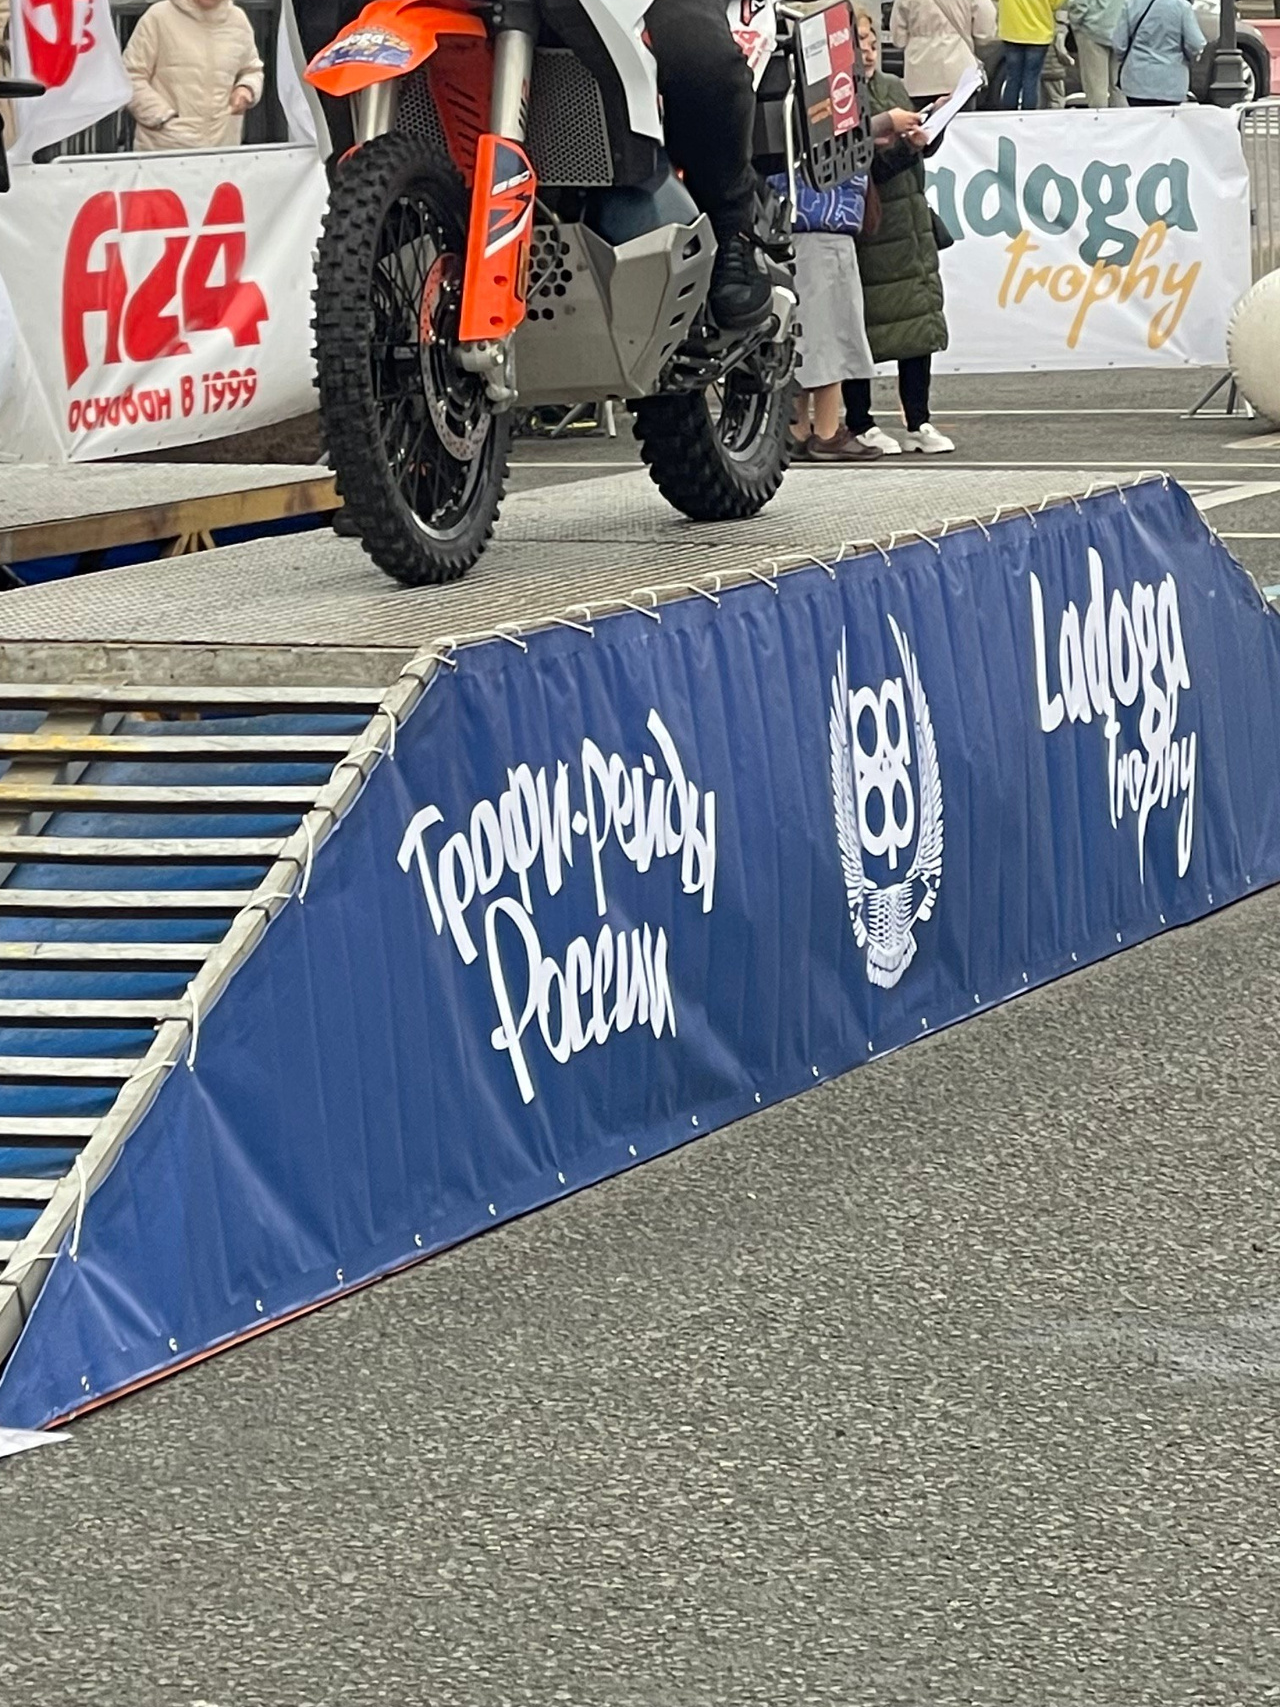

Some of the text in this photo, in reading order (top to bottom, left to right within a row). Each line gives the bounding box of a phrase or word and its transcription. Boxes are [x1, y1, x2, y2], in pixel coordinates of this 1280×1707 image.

[924, 135, 1198, 268] adoga
[998, 220, 1202, 350] trophy
[202, 367, 258, 415] 1999
[1030, 546, 1191, 754] Ladoga
